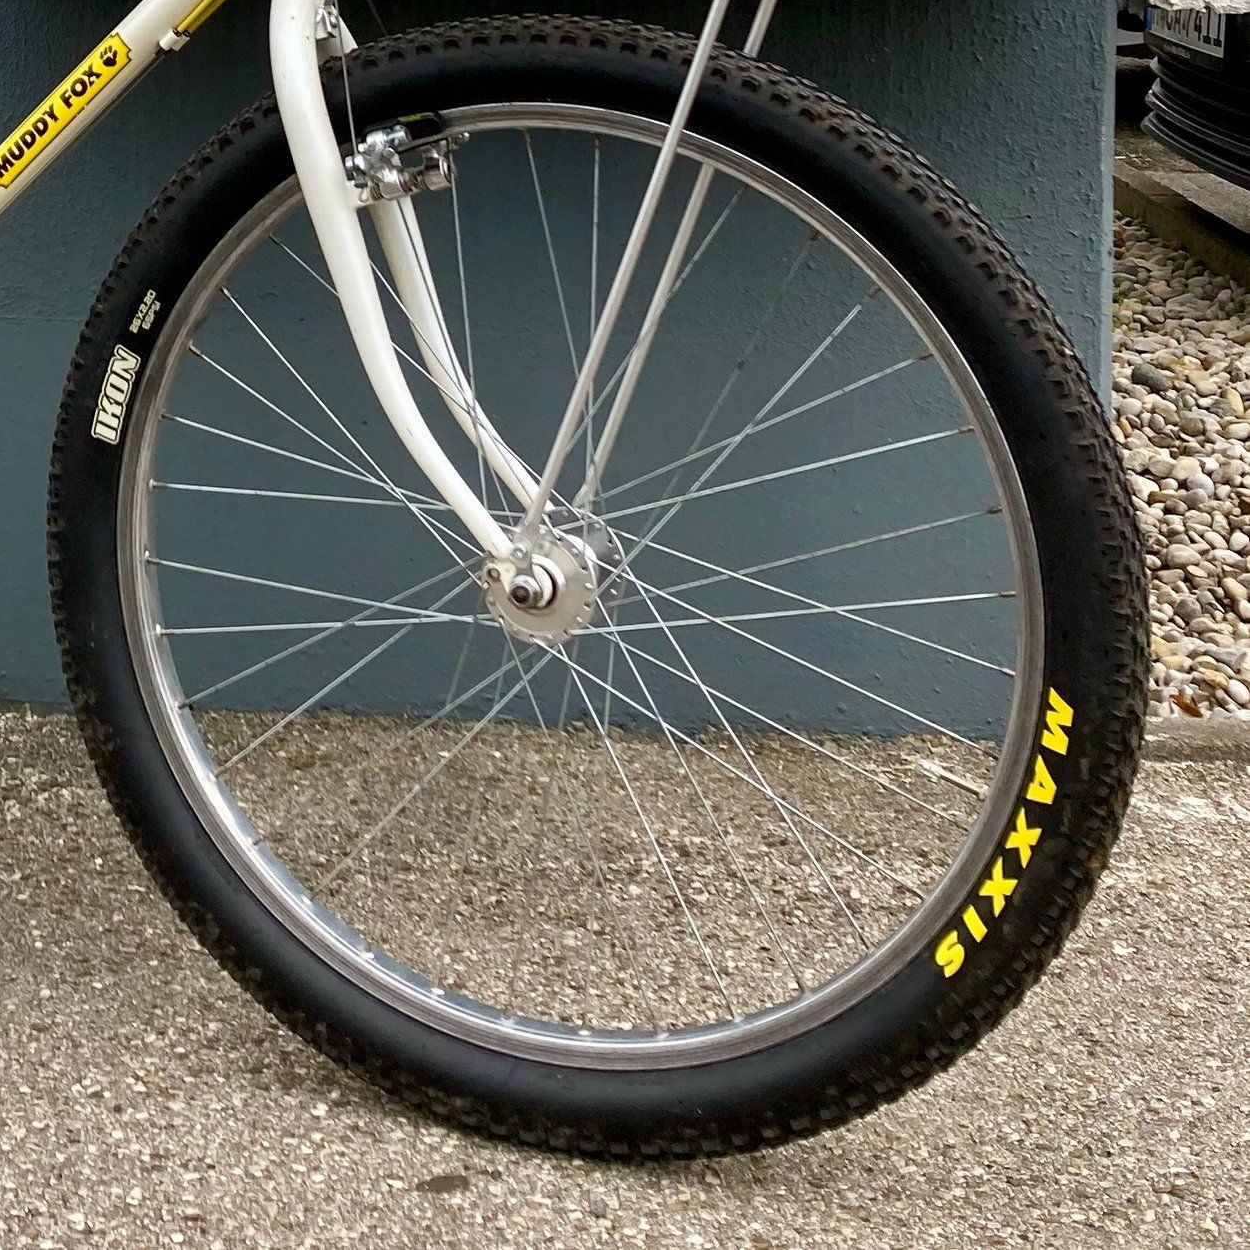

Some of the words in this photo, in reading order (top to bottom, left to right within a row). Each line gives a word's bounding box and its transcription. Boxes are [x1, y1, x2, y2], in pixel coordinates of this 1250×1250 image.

[59, 63, 103, 110] FOX
[91, 344, 142, 445] IKON
[934, 686, 1075, 979] MAXXIS
